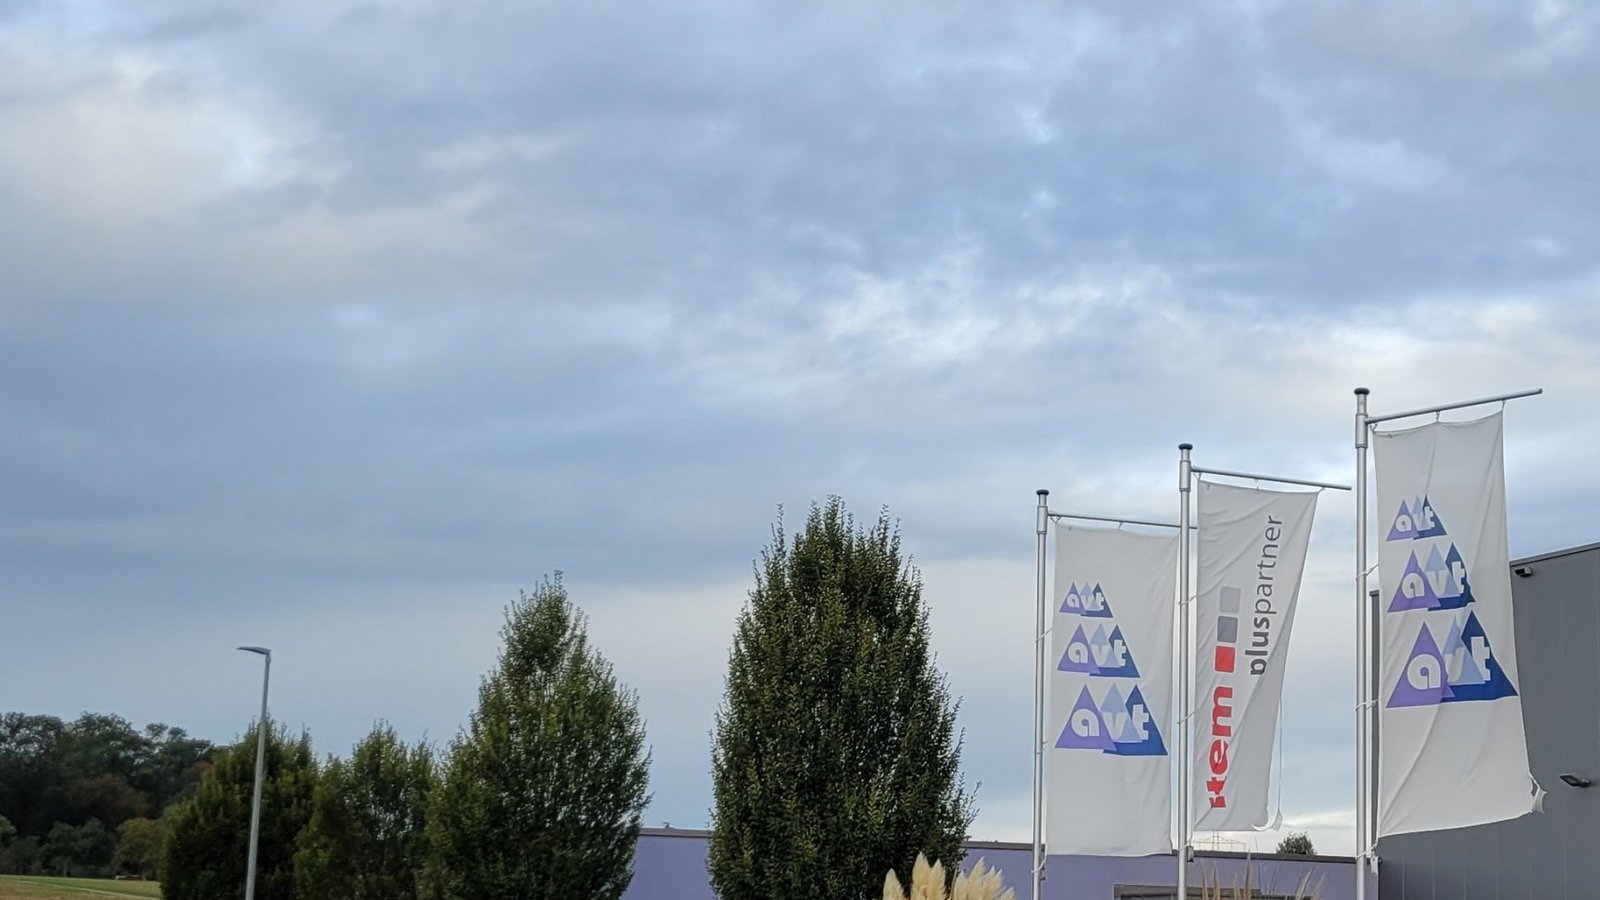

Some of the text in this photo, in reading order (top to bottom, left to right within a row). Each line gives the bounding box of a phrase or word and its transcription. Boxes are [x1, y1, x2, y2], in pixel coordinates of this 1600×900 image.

[1395, 506, 1435, 531] avt
[1401, 561, 1465, 598] avt
[1066, 592, 1104, 611] avt
[1067, 639, 1126, 667] avt
[1407, 636, 1491, 690] avt
[1071, 704, 1150, 742] avt
